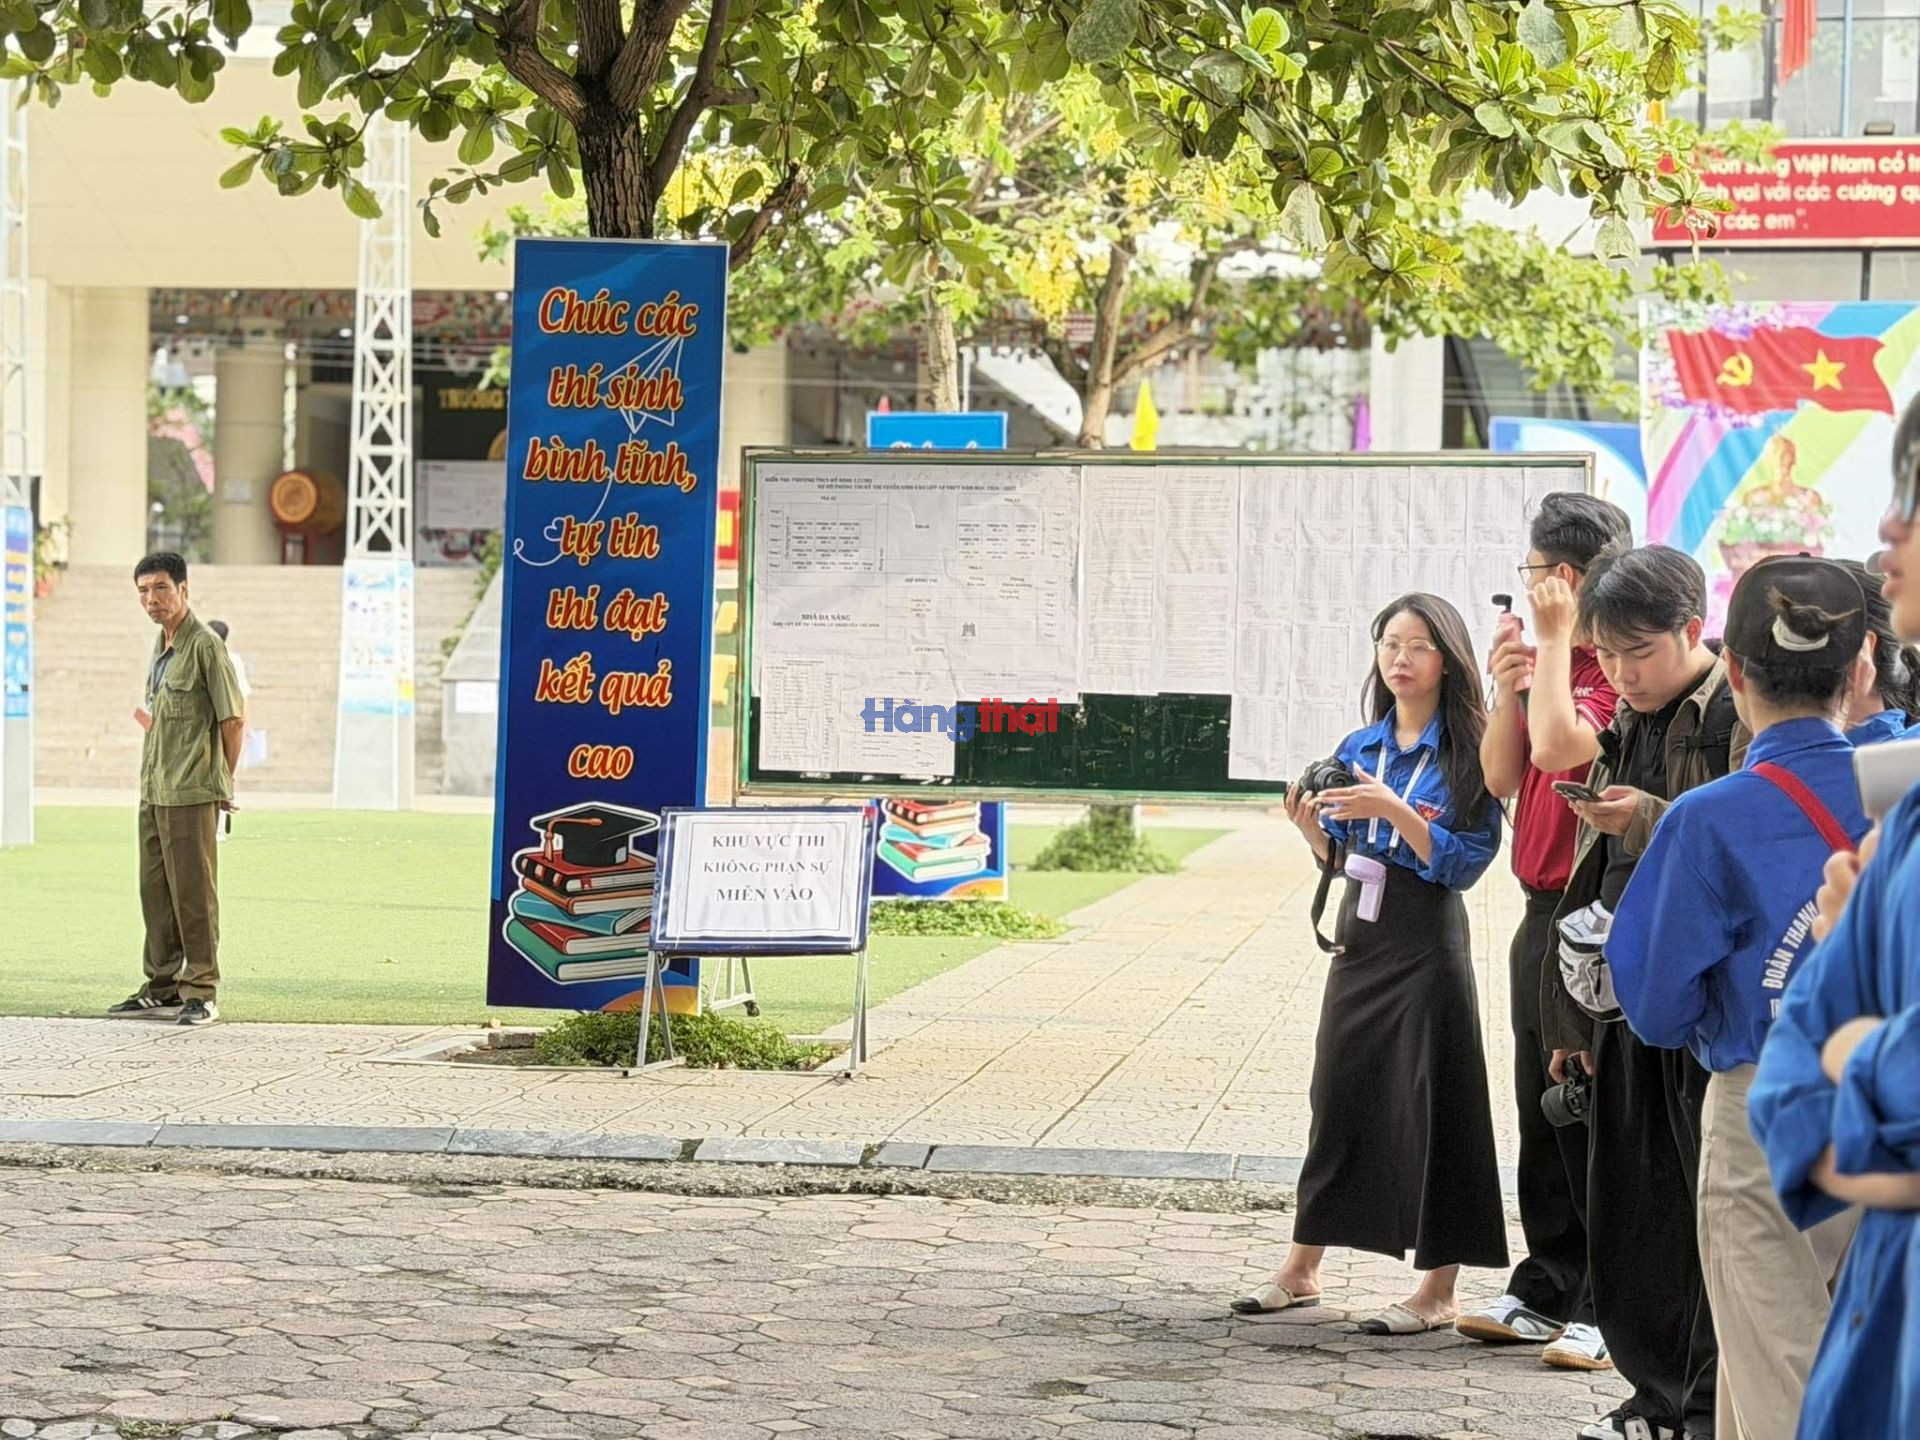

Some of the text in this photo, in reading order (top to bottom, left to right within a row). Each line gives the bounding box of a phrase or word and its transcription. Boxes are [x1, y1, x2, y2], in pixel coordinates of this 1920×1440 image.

[1831, 154, 1876, 174] Nam
[1878, 149, 1905, 174] có
[1793, 179, 1831, 202] các
[1723, 208, 1760, 230] các
[539, 287, 698, 336] Chúc các
[548, 363, 683, 410] thí sinh
[523, 435, 697, 493] bình tĩnh,
[560, 512, 660, 566] tự tin
[546, 585, 669, 642] thi đạt
[535, 651, 672, 715] kết quả
[568, 744, 634, 780] cao
[712, 832, 825, 850] KHU VỰC THI
[703, 858, 761, 873] KHÔNG
[810, 859, 833, 875] SỰ
[772, 882, 813, 901] VÀO
[1782, 900, 1820, 950] THANH
